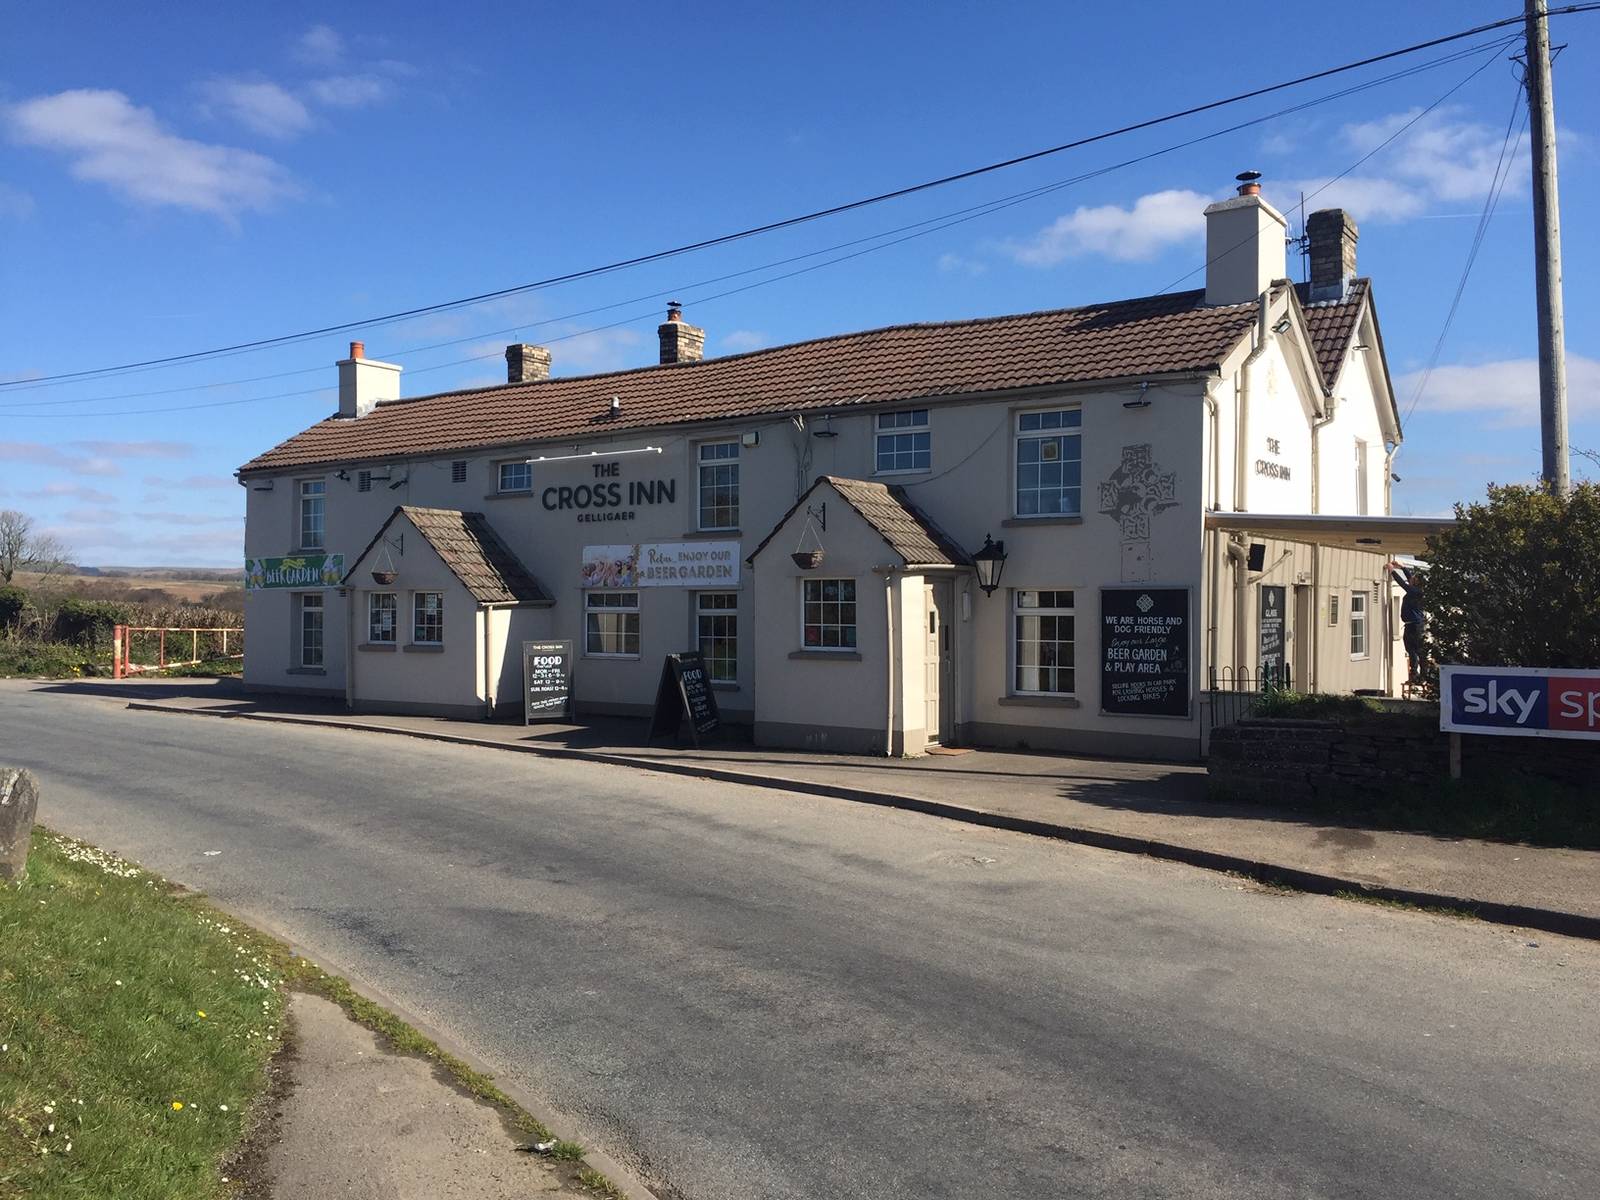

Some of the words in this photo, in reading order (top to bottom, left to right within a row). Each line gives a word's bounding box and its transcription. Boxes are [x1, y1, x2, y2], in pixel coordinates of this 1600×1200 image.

[1266, 437, 1280, 455] THE
[592, 462, 620, 478] THE
[1256, 459, 1278, 478] CROSS
[1280, 465, 1290, 480] INN
[542, 482, 620, 511] CROSS
[629, 479, 676, 505] INN
[577, 512, 635, 522] GELLIGAER
[678, 551, 710, 562] ENJOY
[710, 550, 731, 560] OUR
[286, 567, 318, 584] GARDEN
[648, 566, 677, 580] BEER
[678, 565, 732, 578] GARDEN
[1106, 616, 1118, 624] WE
[1120, 616, 1134, 624] ARE
[1137, 616, 1164, 625] HORSE
[1165, 616, 1182, 625] AND
[1114, 625, 1132, 633] DOG
[1134, 625, 1172, 634] FRIENDLY
[534, 656, 562, 666] FOOD
[1108, 648, 1130, 660] BEER
[1132, 648, 1168, 661] GARDEN
[683, 668, 702, 681] FOOD
[1104, 662, 1112, 672] &
[1114, 662, 1136, 672] PLAY
[1138, 662, 1161, 674] AREA
[1462, 680, 1540, 724] sky
